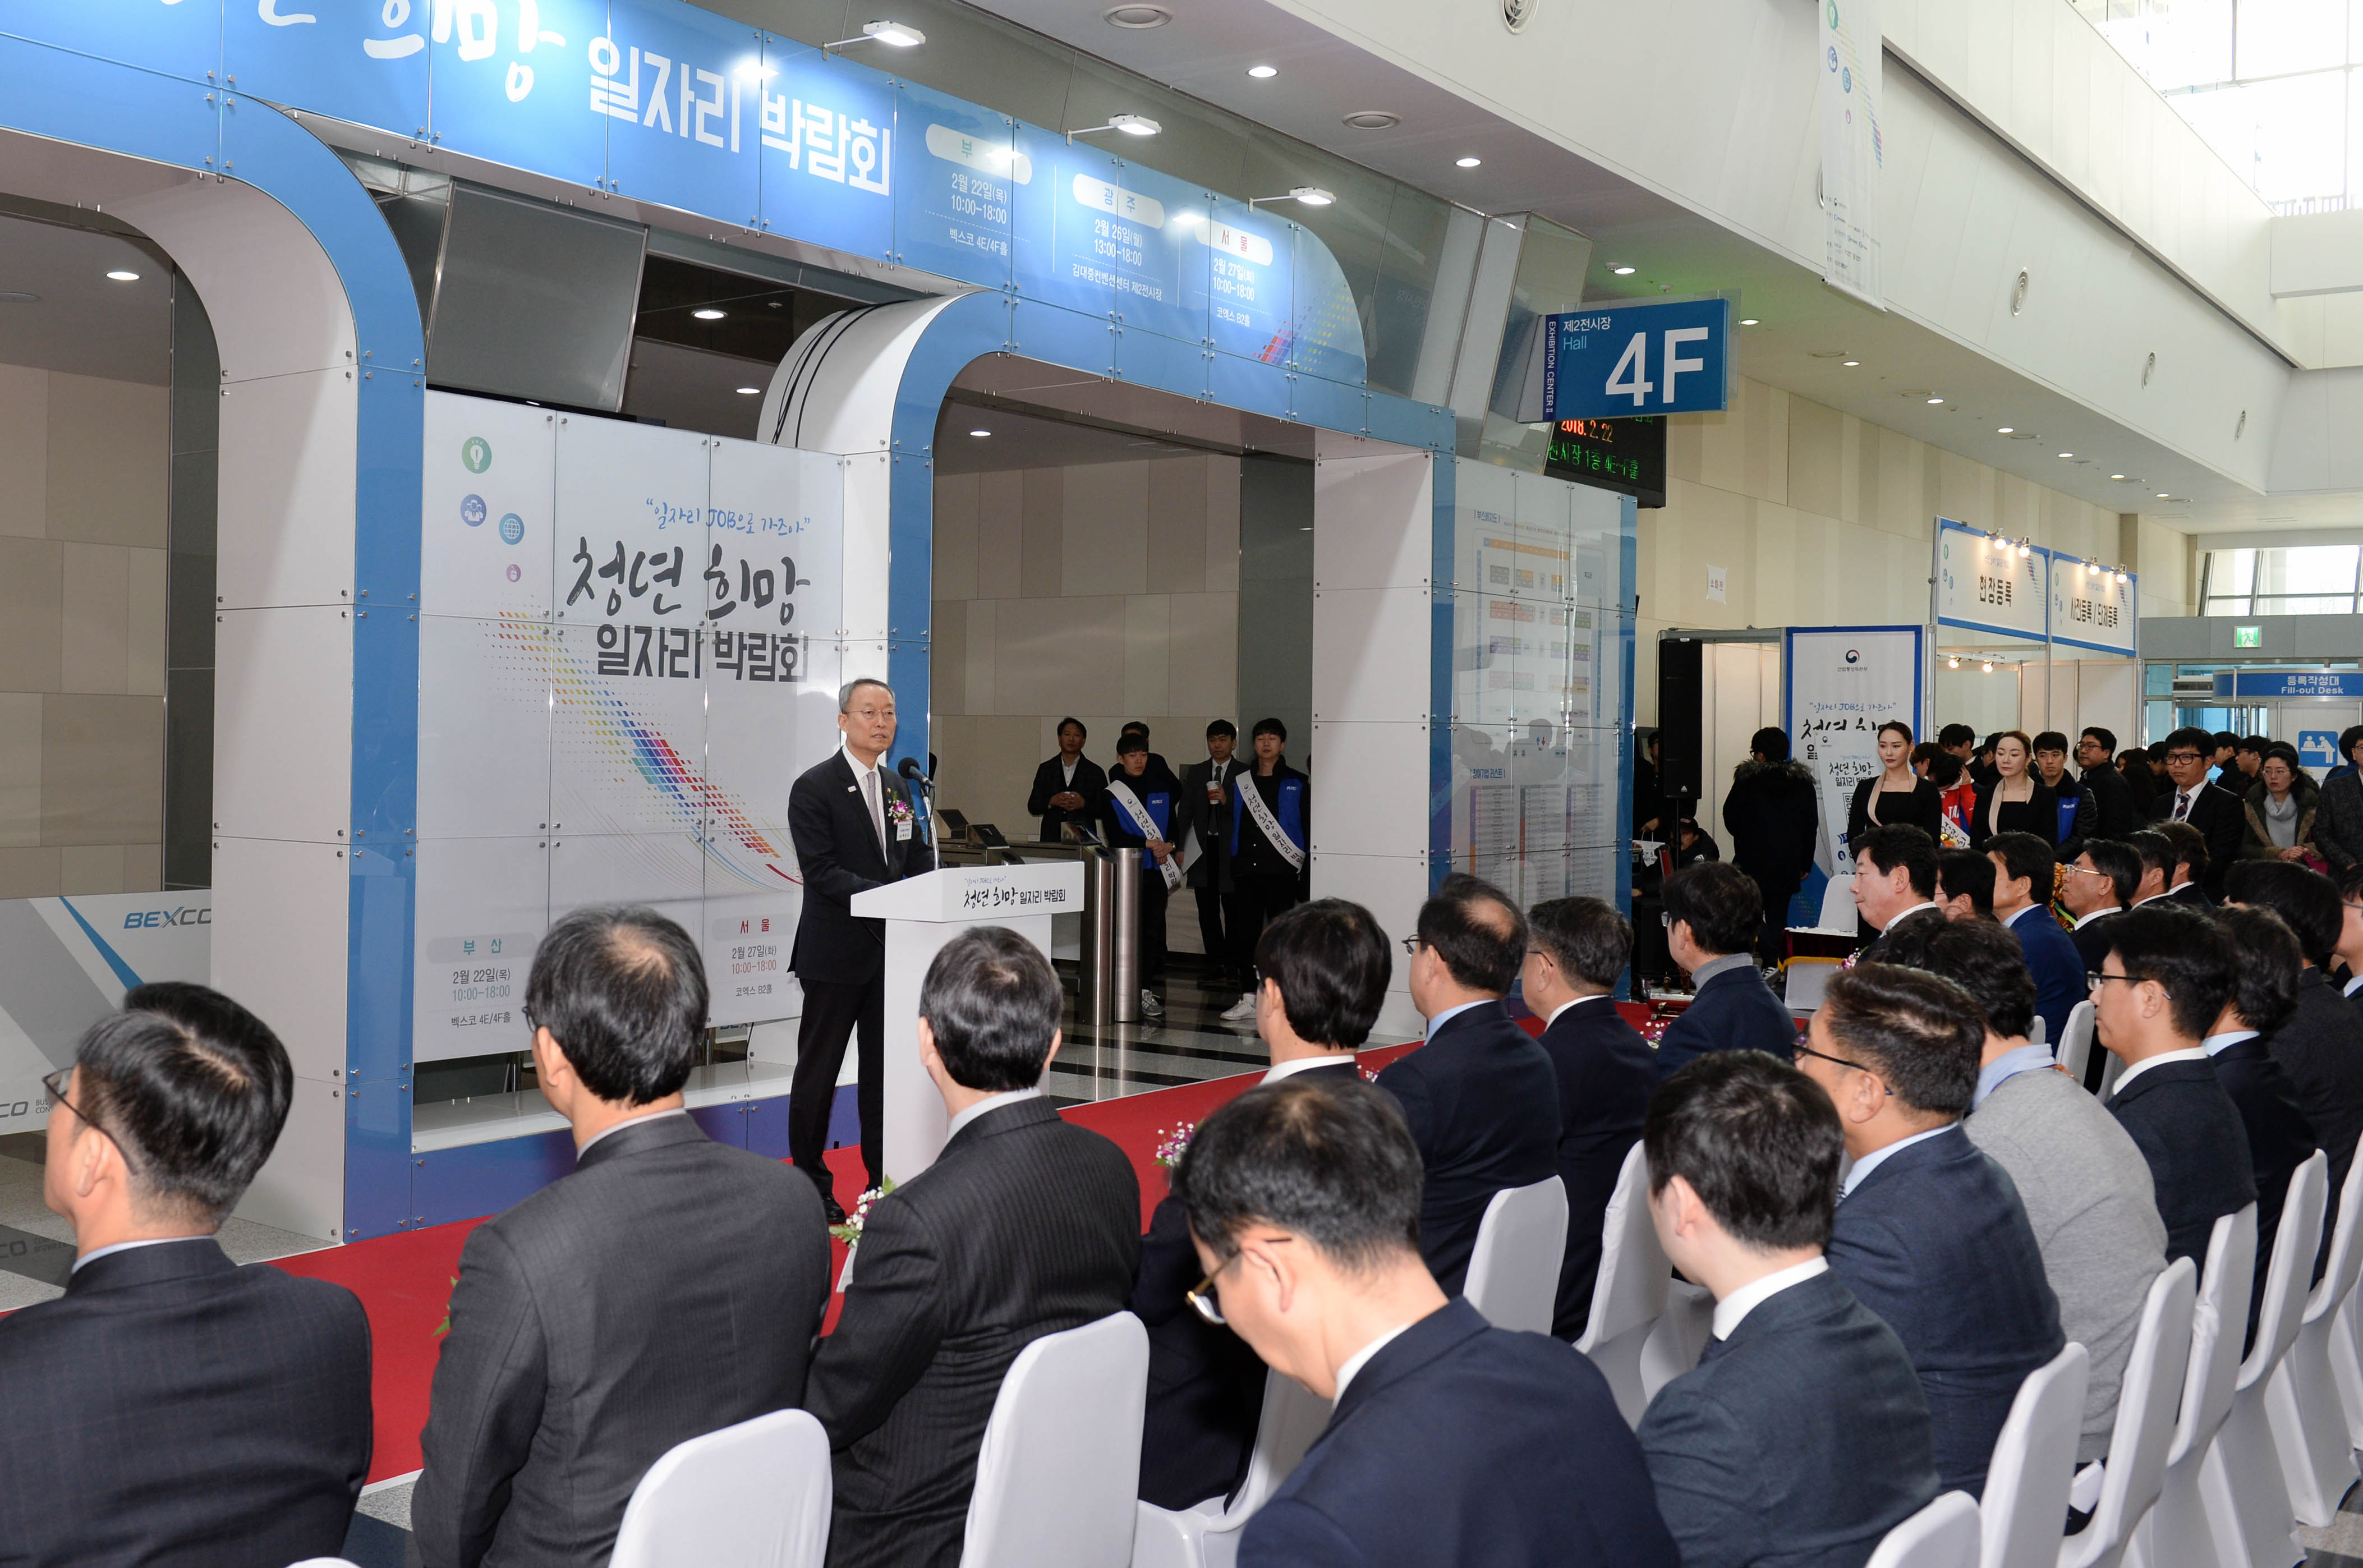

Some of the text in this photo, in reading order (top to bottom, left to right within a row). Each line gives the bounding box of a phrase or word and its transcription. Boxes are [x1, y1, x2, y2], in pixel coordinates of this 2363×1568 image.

[587, 36, 740, 153] 일자리
[759, 87, 890, 196] 박람회
[951, 173, 1007, 205] 2월 22일(목)
[951, 194, 1007, 224] 10:00-18:00
[949, 227, 1008, 256] 벡스코 4E/4F홀
[1095, 218, 1142, 249] 2월 26일(월)
[1095, 238, 1142, 266] 13:00-18:00
[1072, 263, 1162, 301] 김대중컨벤션센터 제2전시장
[1213, 257, 1254, 284] 2월 27일(화)
[1213, 276, 1255, 301] 10:00-18:00
[1216, 307, 1251, 328] 코엑스 B2홀
[1563, 316, 1611, 333] 제2전시장
[1547, 321, 1556, 369] EXHIBITION
[1563, 335, 1587, 351] Hall
[1605, 327, 1709, 407] 4F
[705, 508, 755, 534] JOB으로
[566, 536, 811, 626] 청년 희망
[1979, 574, 2012, 608] 현장등록
[596, 623, 808, 683] 일자리 박람회
[2287, 675, 2340, 686] 등록작성대
[1829, 761, 1875, 776] 청년 희망
[1835, 776, 1856, 787] 일자리
[963, 886, 1066, 909] 청년 희망 일자리 박람회
[732, 944, 777, 959] 2월 27일(화)
[453, 967, 511, 985] 2월 22일(목)
[731, 959, 777, 974] 10:00-18:00
[453, 984, 511, 1001] 10:00-18:00
[735, 983, 773, 997] 코엑스 B2홀
[451, 1011, 512, 1028] 벡스코 4E/4F홀
